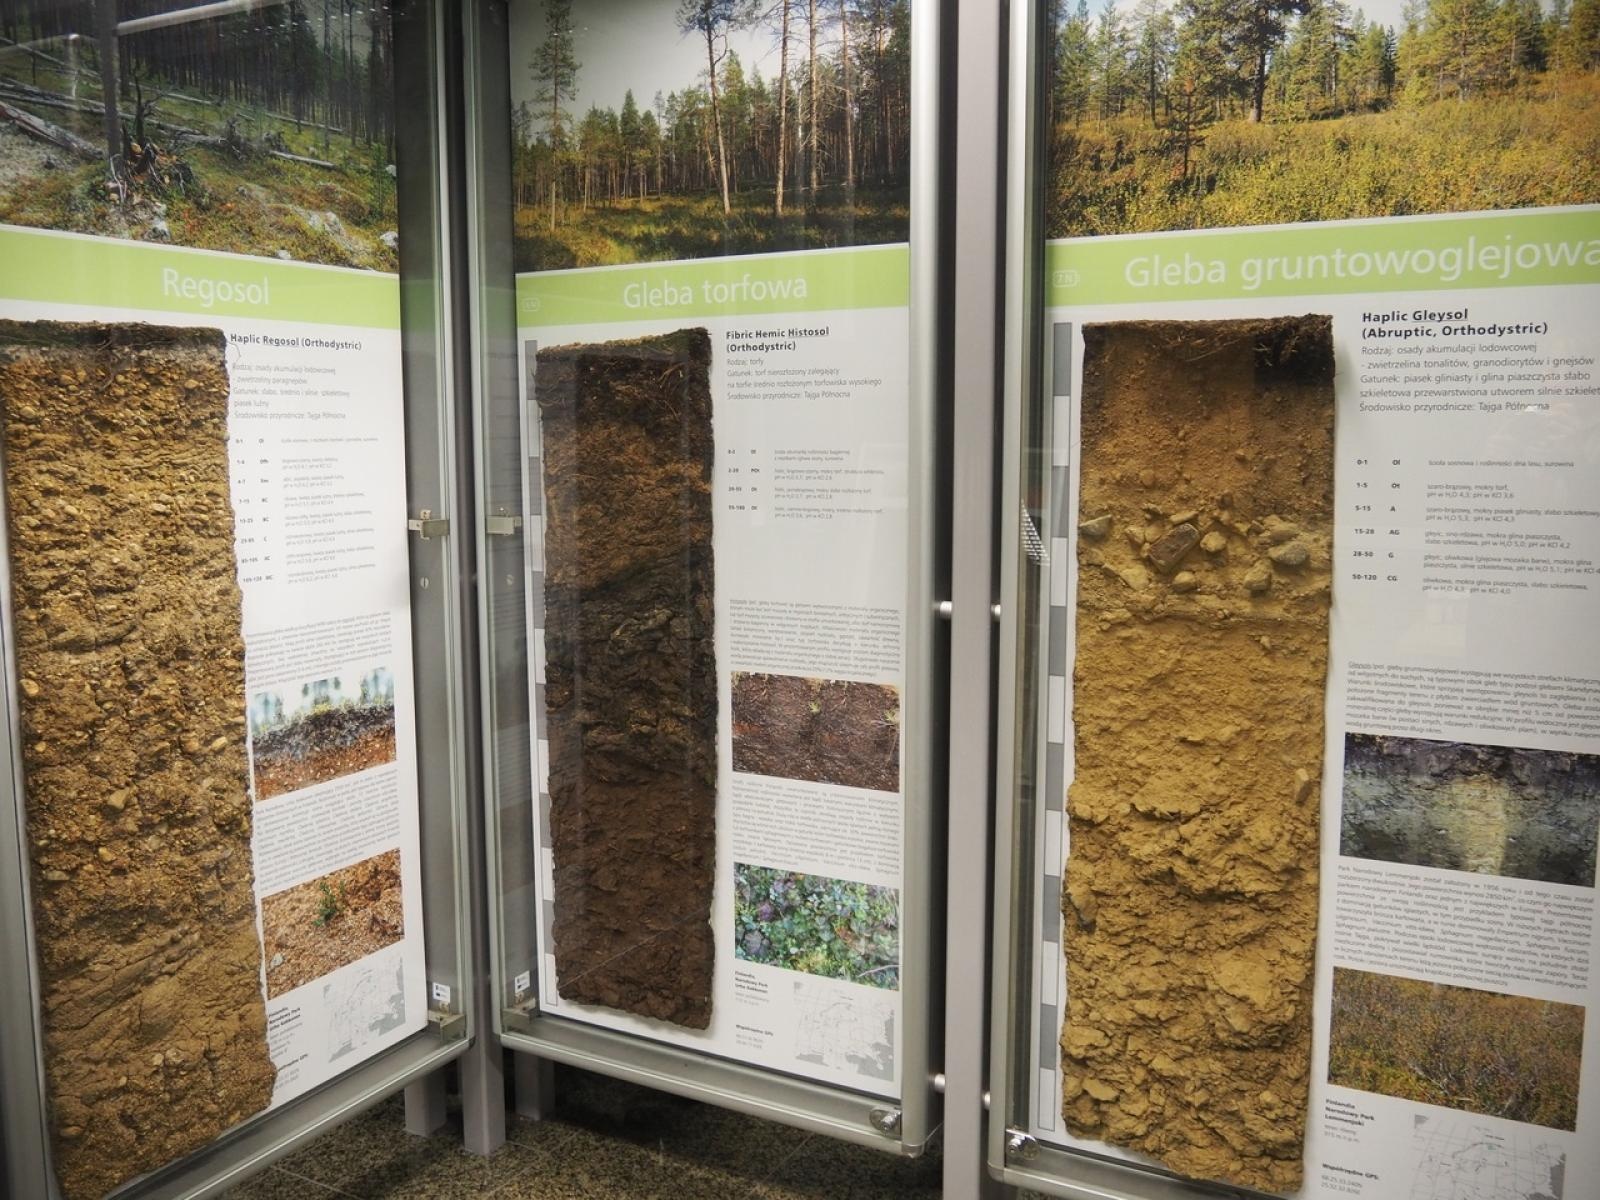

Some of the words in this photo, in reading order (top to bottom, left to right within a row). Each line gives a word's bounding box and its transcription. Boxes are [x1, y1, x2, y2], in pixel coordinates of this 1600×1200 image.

[1124, 250, 1226, 287] Gleba
[1241, 234, 1600, 290] gruntowoglejowa
[163, 268, 269, 307] Regosol
[623, 282, 693, 309] Gleba
[702, 273, 807, 304] torfowa
[1362, 311, 1408, 324] Haplic
[1413, 308, 1468, 323] Gleysol
[726, 330, 753, 340] Fibric
[755, 328, 785, 338] Hemic
[788, 326, 829, 337] Histosol
[1362, 326, 1437, 339] (Abruptic,
[1442, 322, 1547, 337] Orthodystric)
[230, 334, 260, 344] Haplic
[263, 336, 299, 346] Regosol
[301, 338, 362, 350] (Orthodystric)
[726, 340, 796, 353] (Orthodystric)
[1397, 345, 1422, 356] osady
[1426, 344, 1476, 354] akumulacji
[1479, 342, 1537, 353] lodowcowej
[1368, 360, 1420, 369] zwietrzelina
[1424, 358, 1470, 368] tonalitów,
[1473, 357, 1544, 369] granodiorytów
[1553, 355, 1594, 367] gnejsów
[1404, 374, 1431, 384] piasek
[1434, 374, 1472, 384] gliniasty
[1481, 373, 1504, 383] glina
[1507, 371, 1560, 383] piaszczysta
[1563, 371, 1590, 381] słabo
[1360, 389, 1411, 398] szkieletowa
[1414, 388, 1487, 399] przewarstwiona
[1491, 388, 1534, 396] utworem
[1359, 400, 1411, 412] Środowisko
[1479, 402, 1502, 412] Tajga
